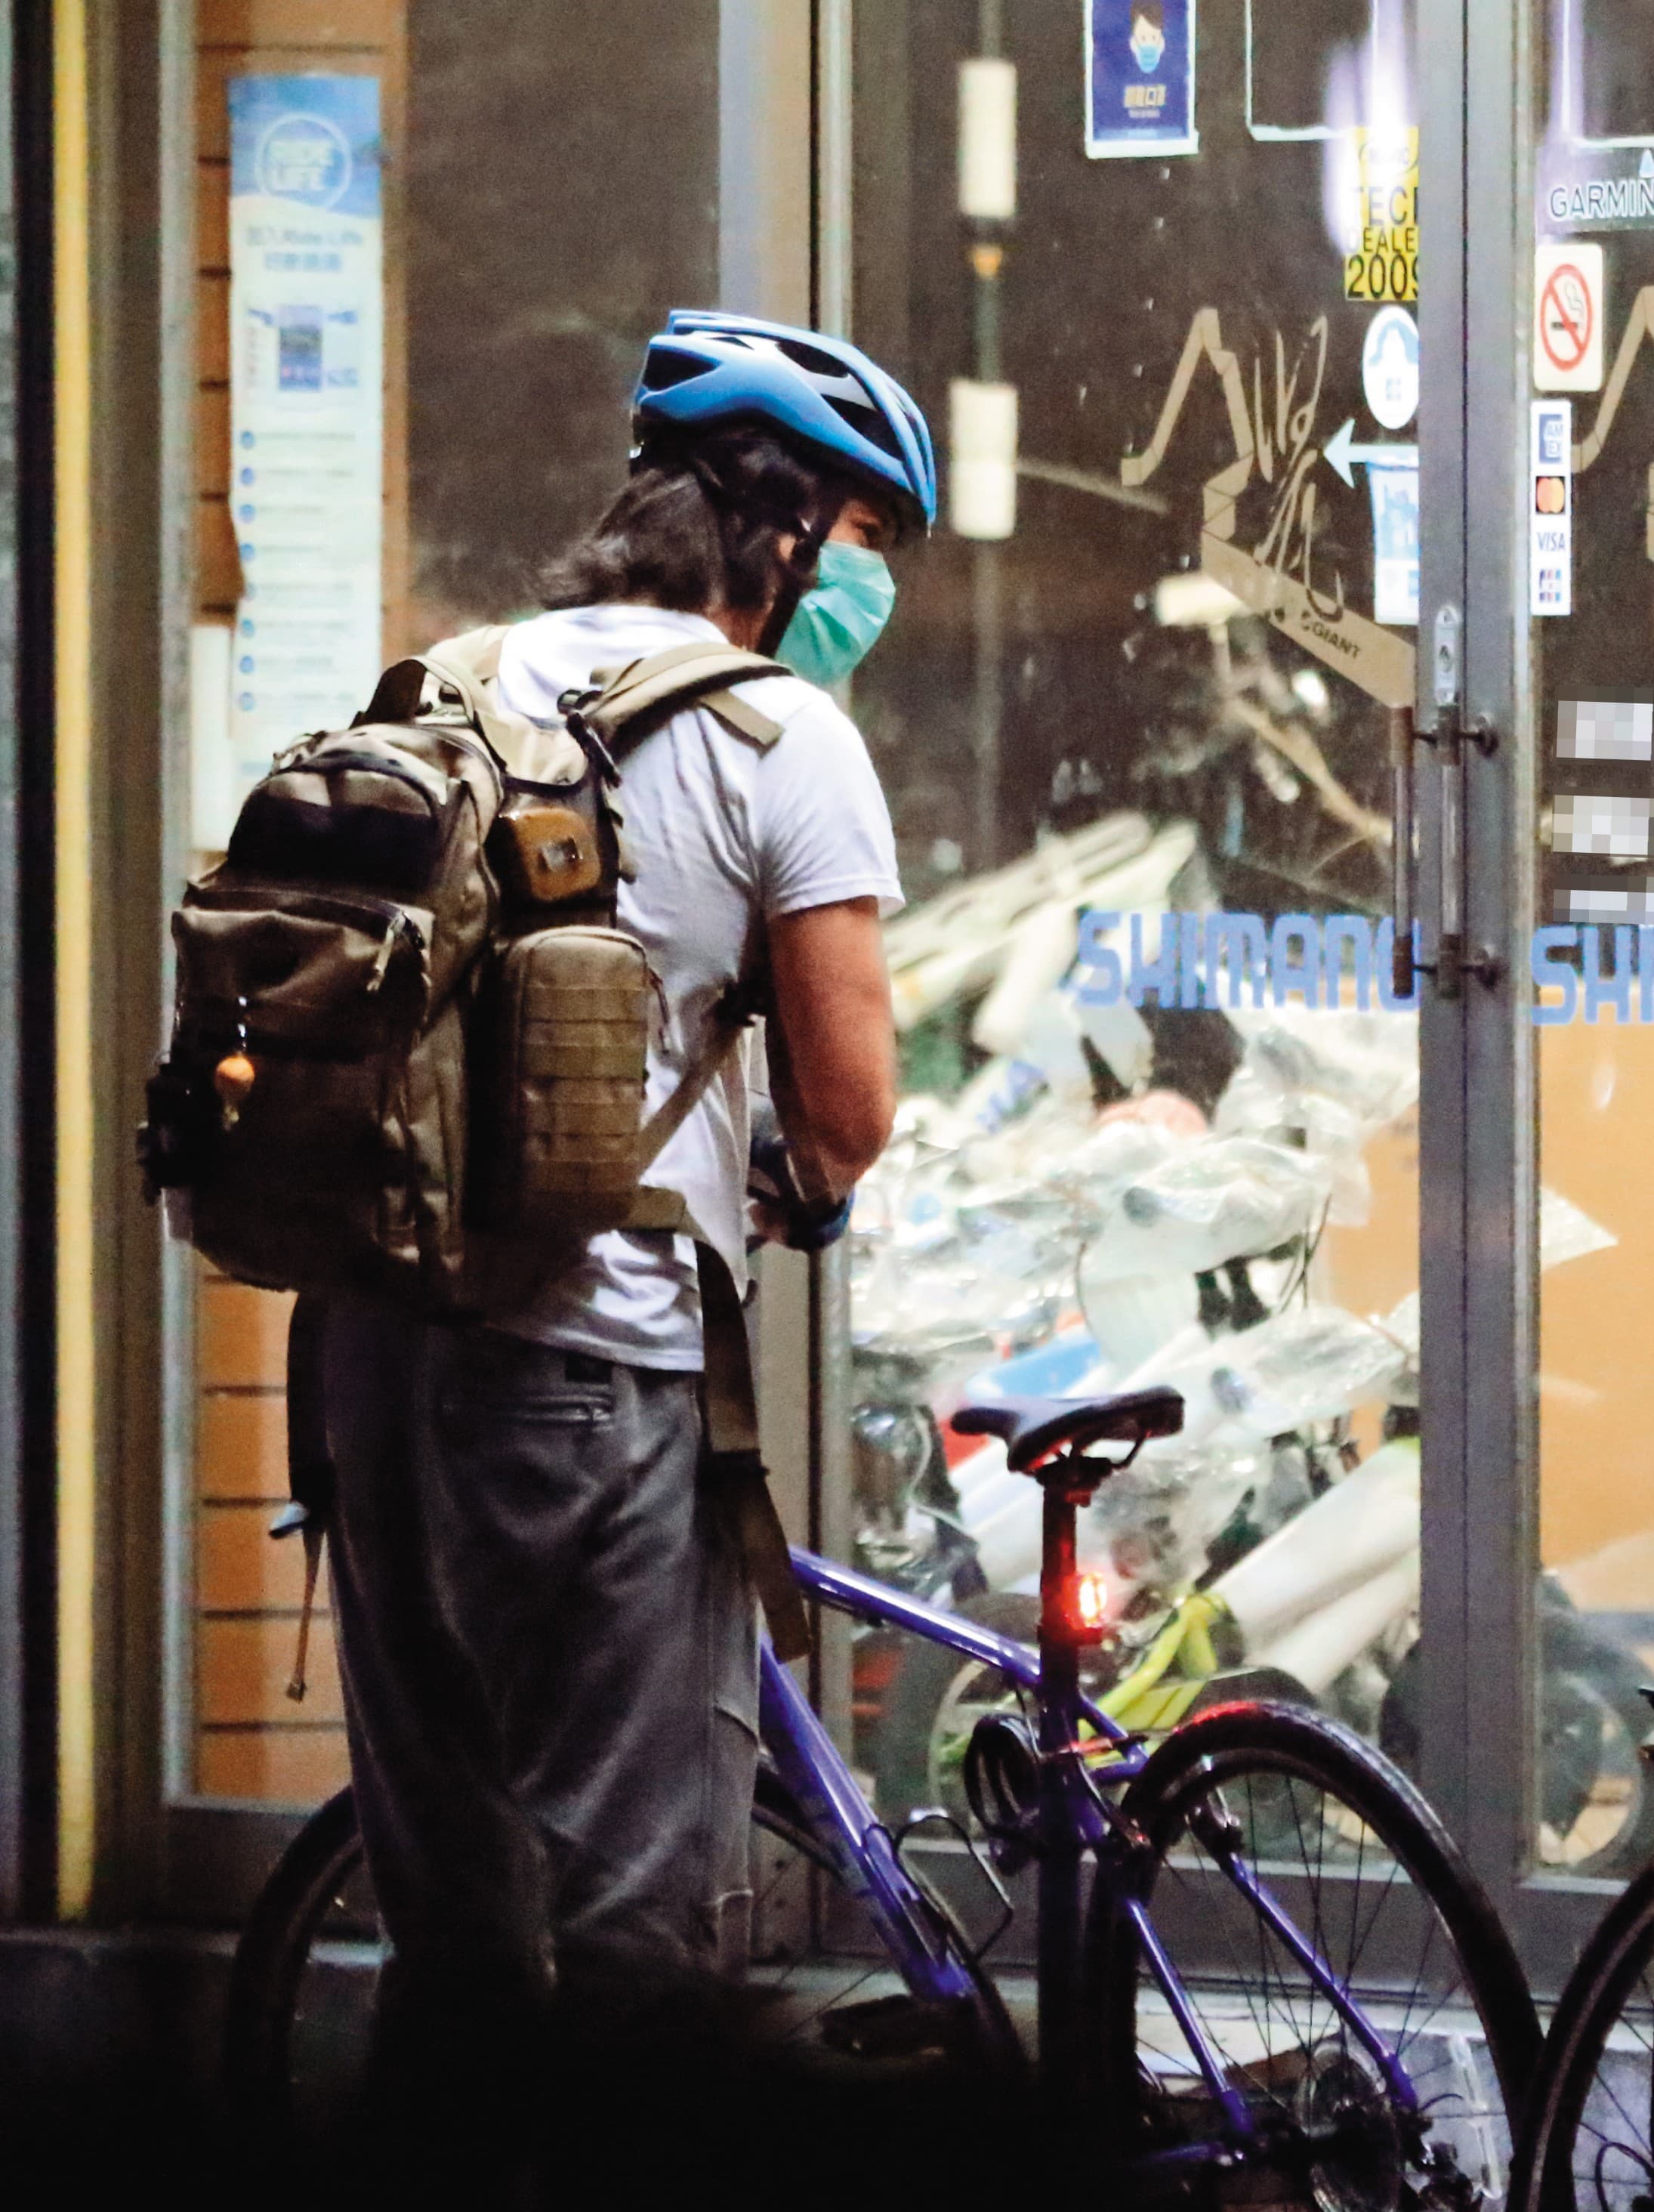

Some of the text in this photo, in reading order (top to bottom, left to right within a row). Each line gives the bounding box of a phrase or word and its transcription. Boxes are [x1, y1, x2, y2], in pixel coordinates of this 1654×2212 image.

[1549, 179, 1654, 221] GARMIN
[1537, 531, 1566, 551] VISA
[1313, 621, 1362, 660] GIANT
